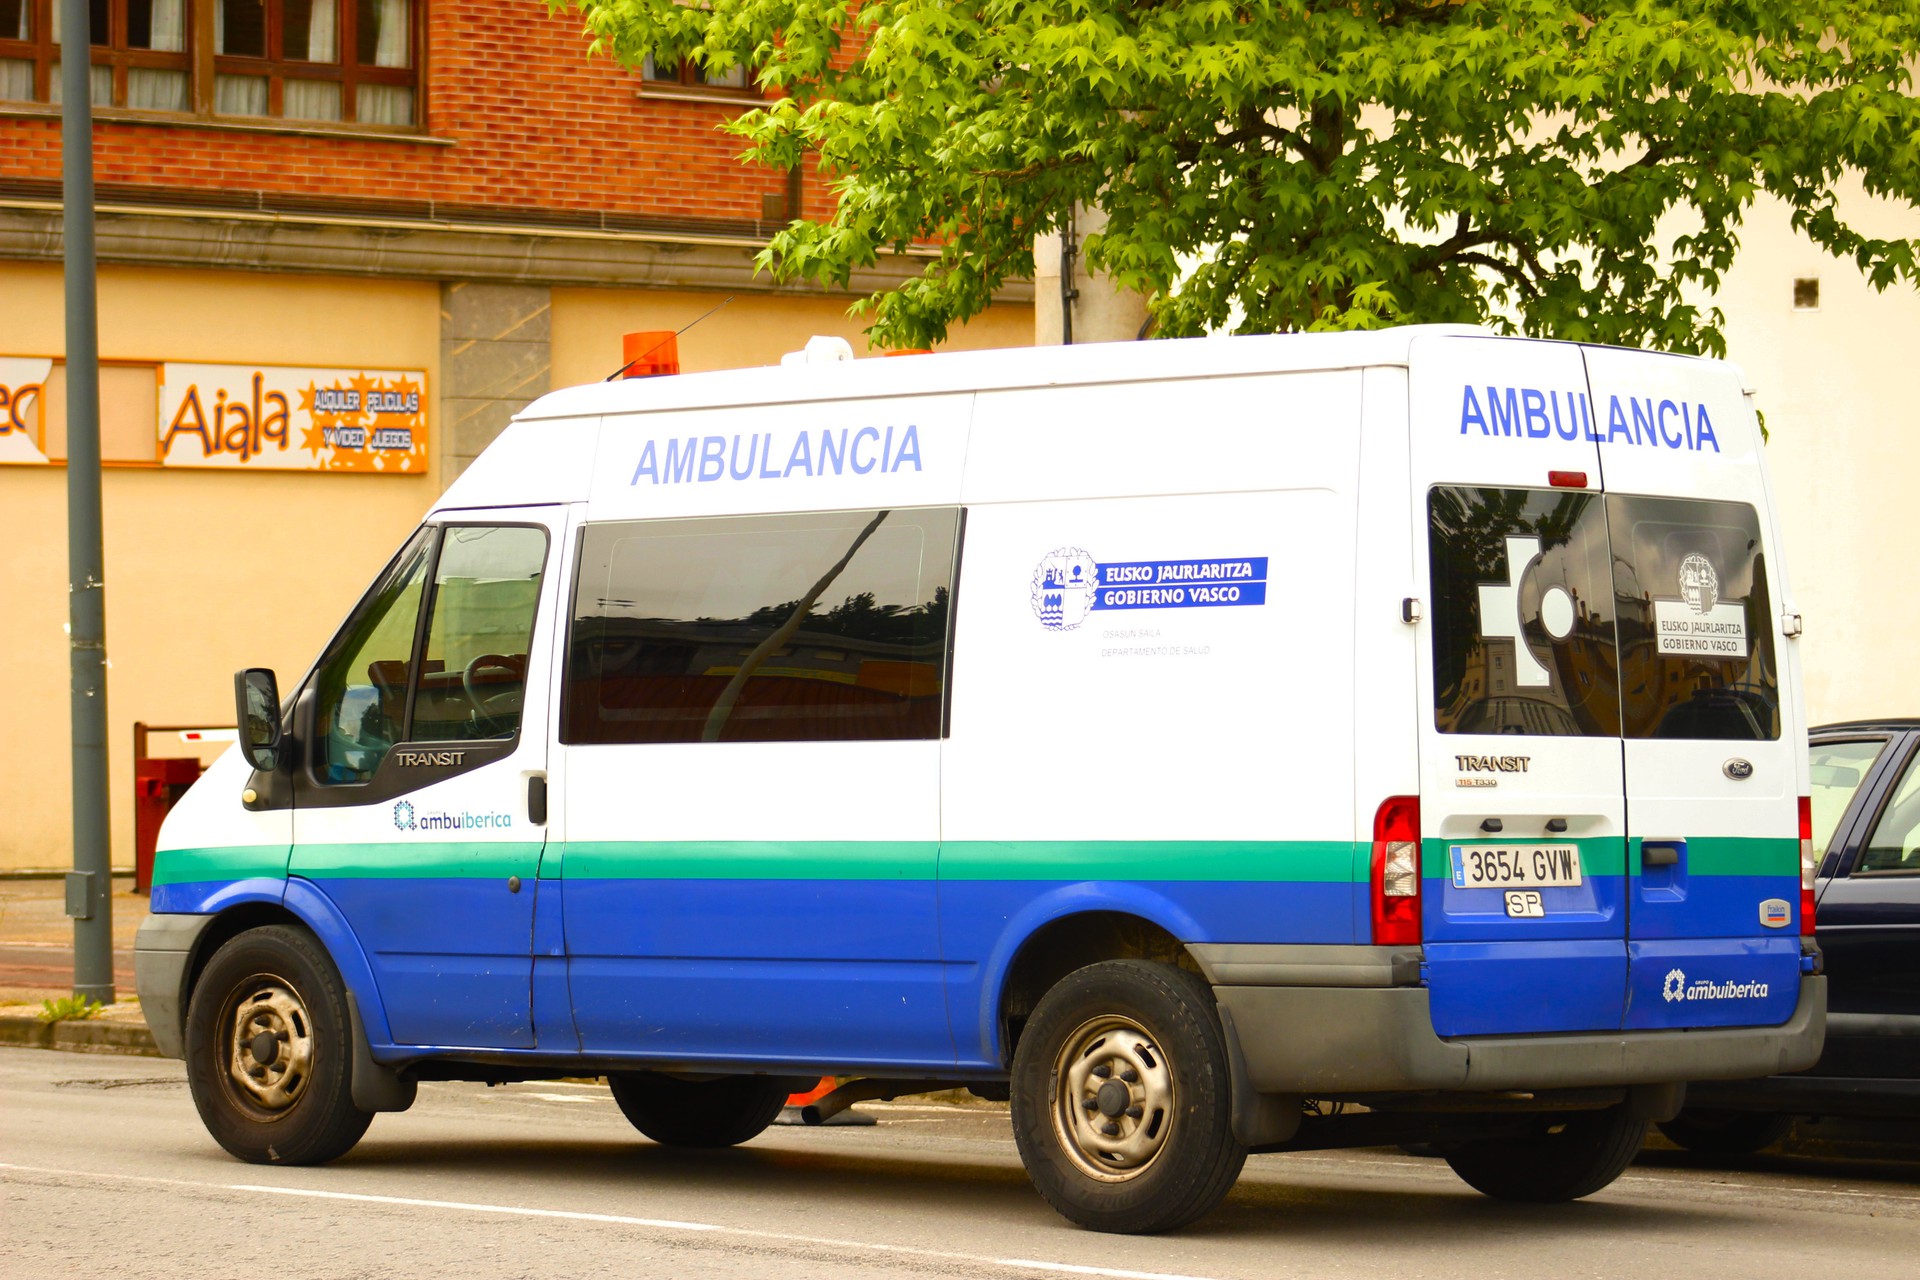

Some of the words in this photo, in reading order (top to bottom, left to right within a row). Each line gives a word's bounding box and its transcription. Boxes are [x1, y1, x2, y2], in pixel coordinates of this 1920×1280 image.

[314, 390, 360, 414] ALQUILER
[162, 371, 290, 463] Aiala
[1460, 385, 1721, 453] AMBULANCIA
[323, 427, 332, 448] Y
[334, 427, 366, 448] VIDEO
[372, 428, 412, 449] JUEGOS
[630, 424, 922, 486] AMBULANCIA
[1105, 566, 1153, 583] EUSKO
[1156, 562, 1252, 583] JAURLARITZA
[1104, 588, 1185, 606] GOBIERNO
[1189, 586, 1240, 603] VASCO
[1661, 620, 1688, 632] EUSKO
[1691, 622, 1742, 634] JAURLARITZA
[1101, 646, 1168, 657] DEPARTAMENTO
[1169, 646, 1181, 656] DE
[1183, 645, 1210, 655] SALUD
[1663, 638, 1708, 650] GOBIERNO
[1710, 640, 1738, 652] VASCO
[396, 752, 466, 767] TRANSIT
[1455, 755, 1531, 772] TRANSIT
[1731, 761, 1750, 775] Ford
[420, 811, 512, 830] ambuiberica
[1456, 871, 1463, 880] E
[1470, 850, 1525, 882] 3654
[1532, 849, 1573, 881] GVW
[1510, 894, 1538, 914] SP
[1686, 980, 1768, 1000] ambuiberica
